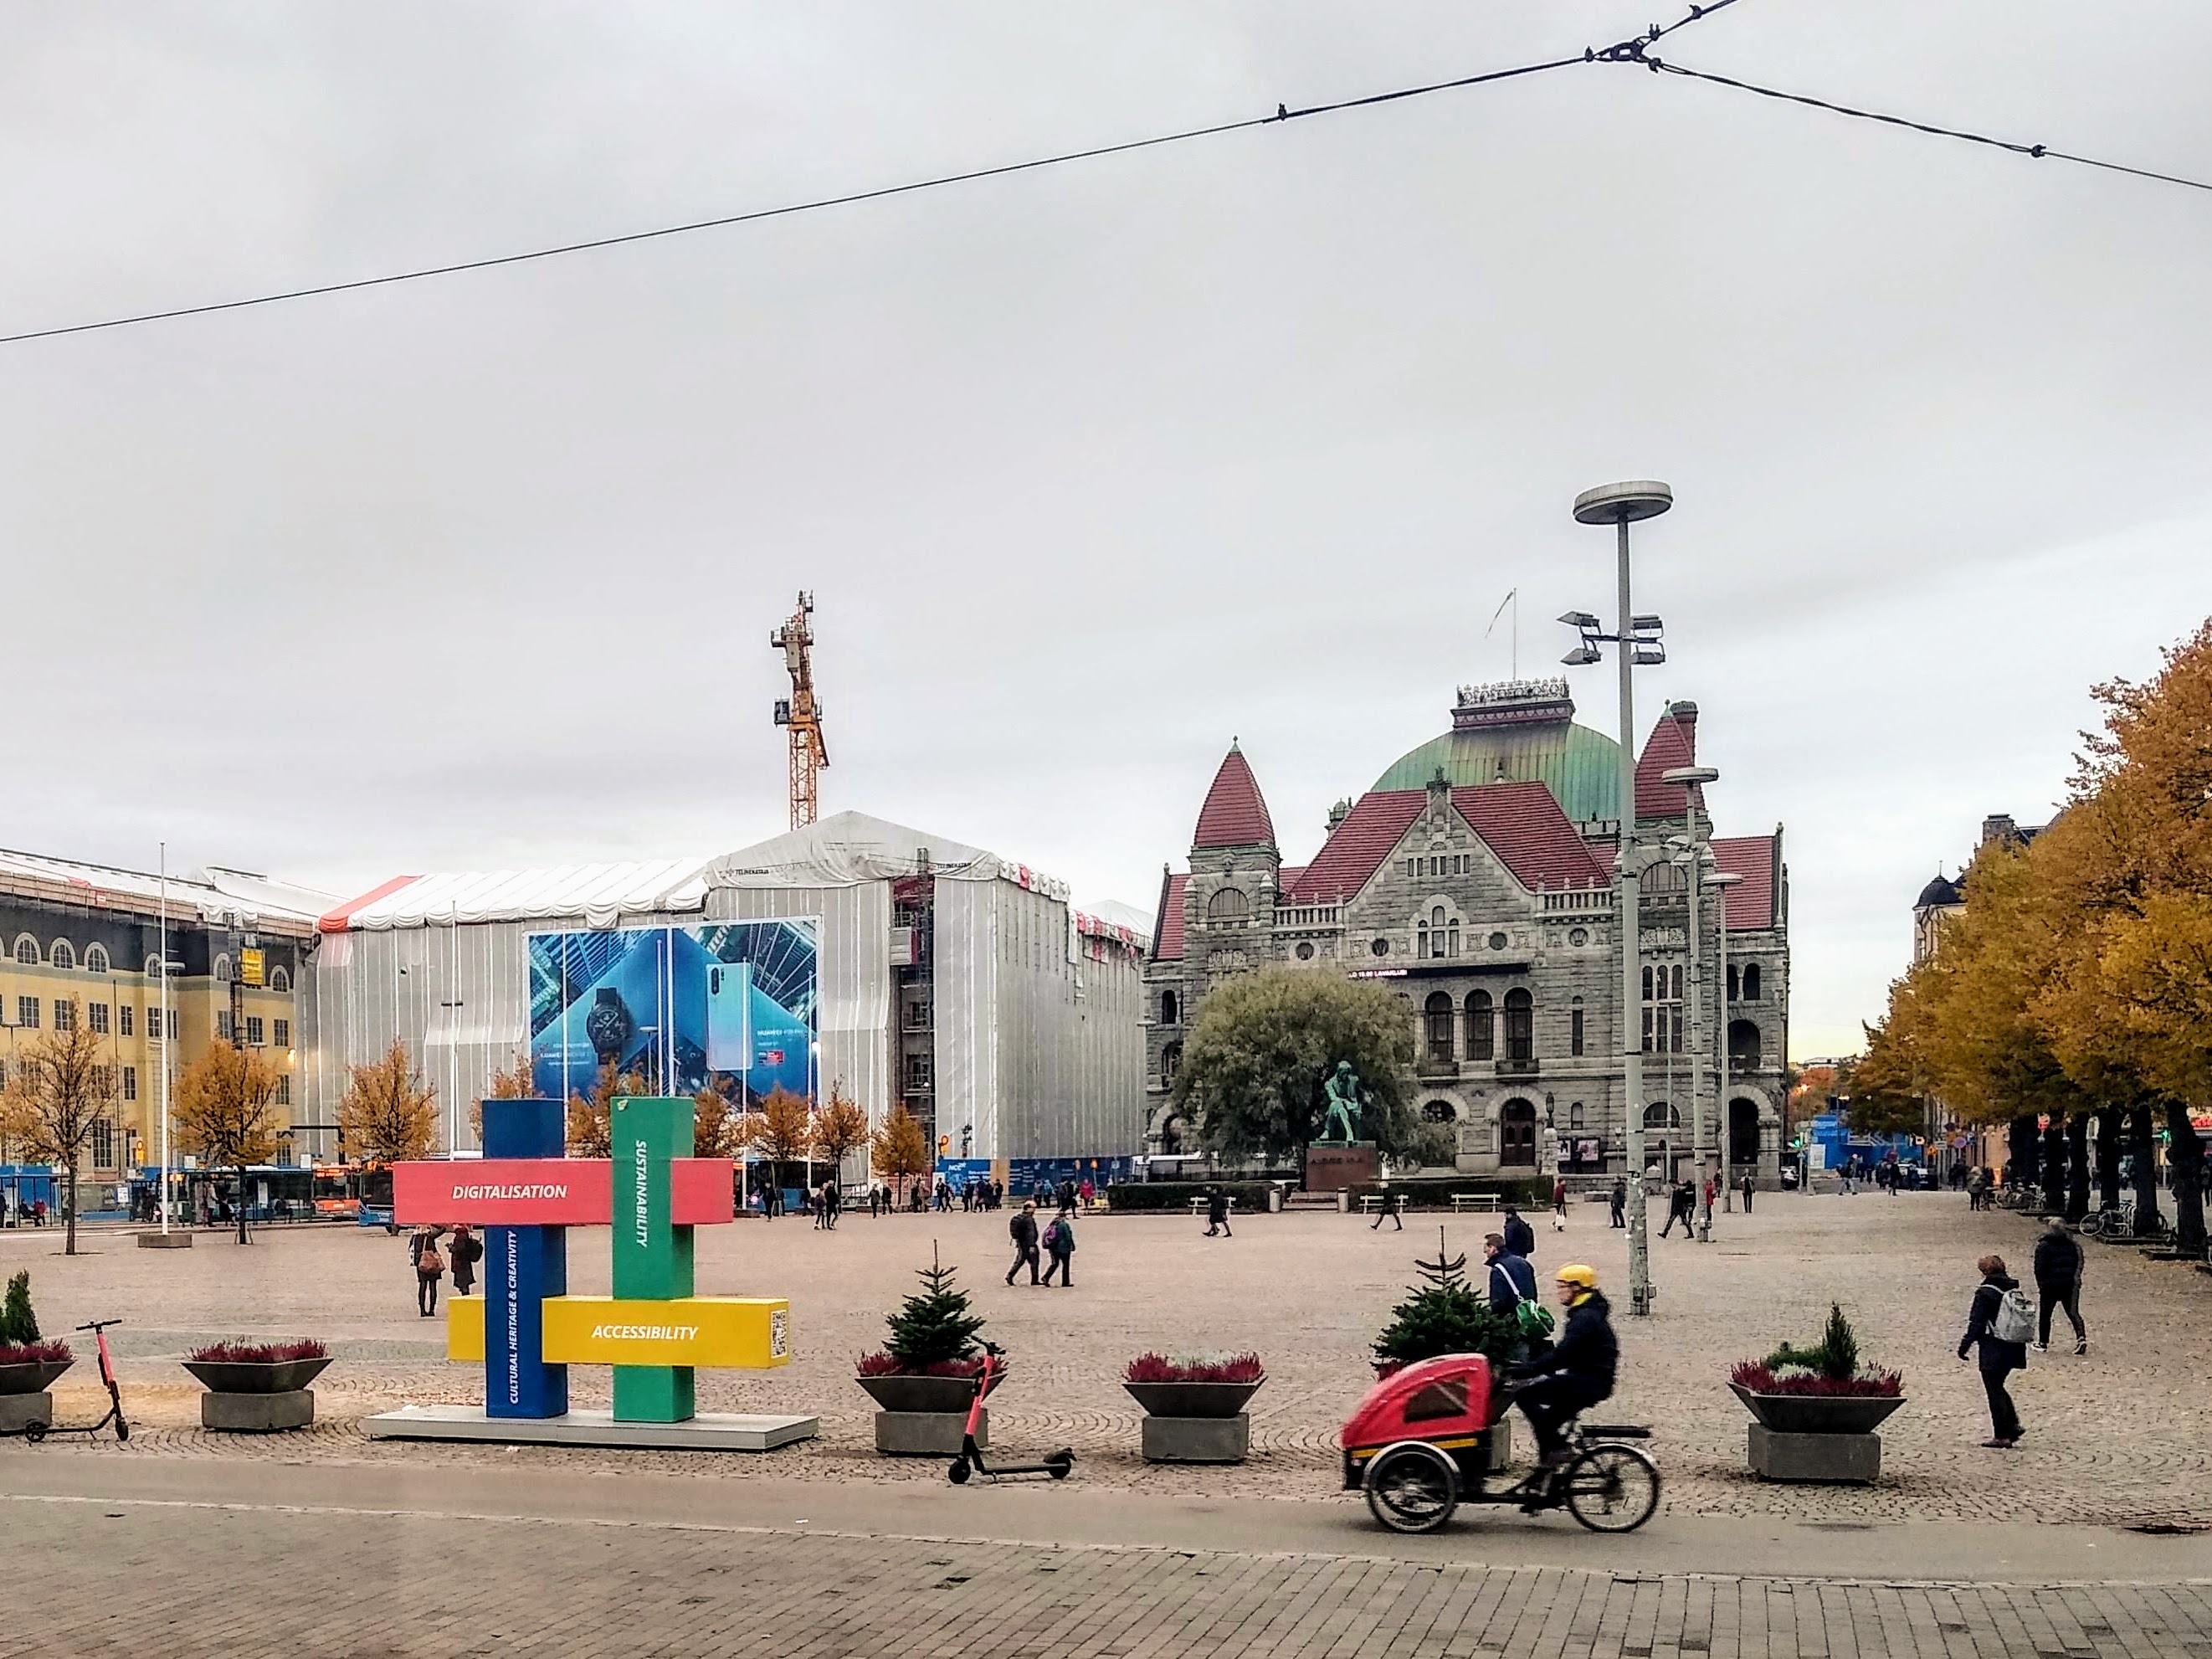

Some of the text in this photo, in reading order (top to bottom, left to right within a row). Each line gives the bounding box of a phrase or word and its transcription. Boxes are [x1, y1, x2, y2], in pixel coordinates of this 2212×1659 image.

[452, 1184, 567, 1199] DIGITALISATION
[635, 1139, 648, 1248] SUSTAINABILITY
[507, 1230, 519, 1405] CULTURAL HERITAGE & CREATIVITY
[591, 1325, 699, 1340] ACCESSIBILITY
